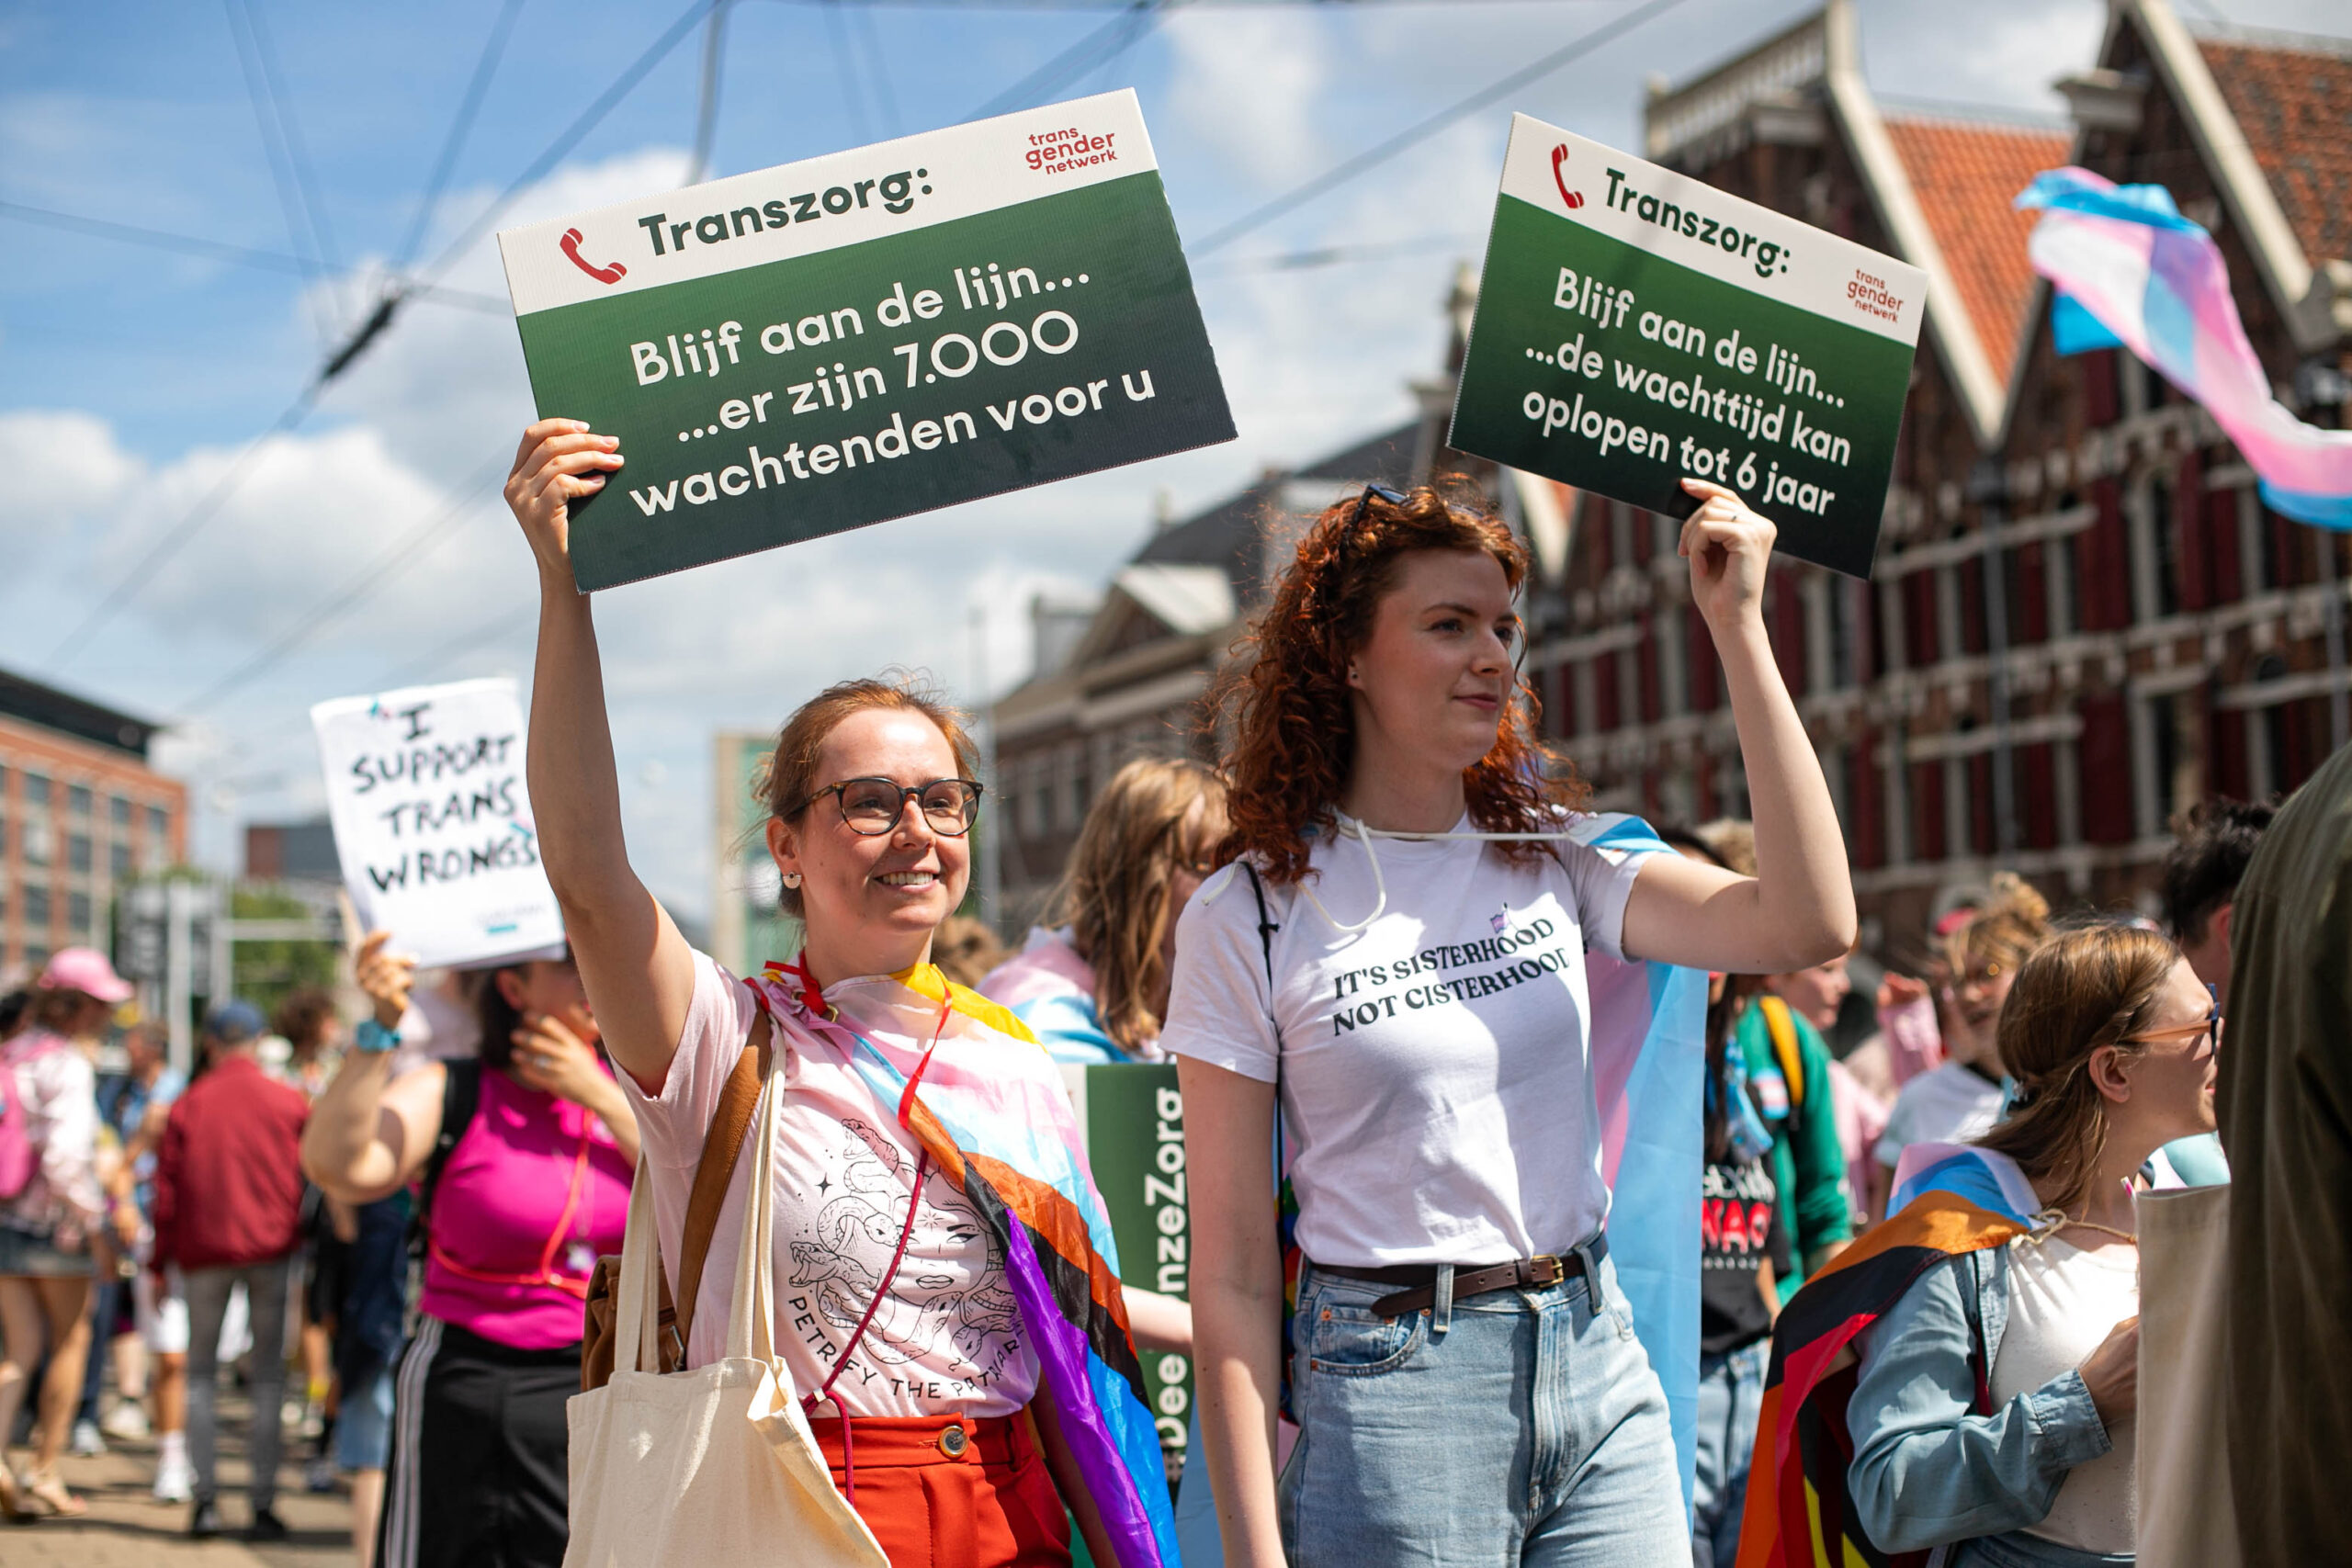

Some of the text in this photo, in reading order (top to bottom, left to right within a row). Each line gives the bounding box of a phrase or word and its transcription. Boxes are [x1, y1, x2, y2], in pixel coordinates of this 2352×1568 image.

[1025, 132, 1115, 170] gender
[1029, 128, 1080, 146] trans
[1046, 149, 1118, 175] netwerk
[638, 166, 934, 257] Transzorg:
[1605, 167, 1791, 277] Transzorg:
[1848, 281, 1904, 310] gender
[1856, 268, 1886, 289] trans
[630, 261, 1091, 387] Blijf aan de lijn...
[1554, 266, 1845, 409] Blijf aan de lijn...
[1855, 299, 1898, 323] netwerk
[678, 309, 1080, 444] ...er zijn 7.000
[1525, 333, 1851, 467] ...de wachttijd kan
[628, 368, 1156, 517] wachtenden voor u
[1522, 390, 1836, 516] oplopen tot 6 jaar
[399, 702, 432, 740] I
[351, 734, 516, 795] SUPPORT
[379, 776, 516, 837] TRANS
[368, 833, 538, 892] WRONGS
[1335, 918, 1555, 999] IT'S SISTERHOOD
[1333, 995, 1397, 1036] NOT
[890, 1379, 942, 1399] THE
